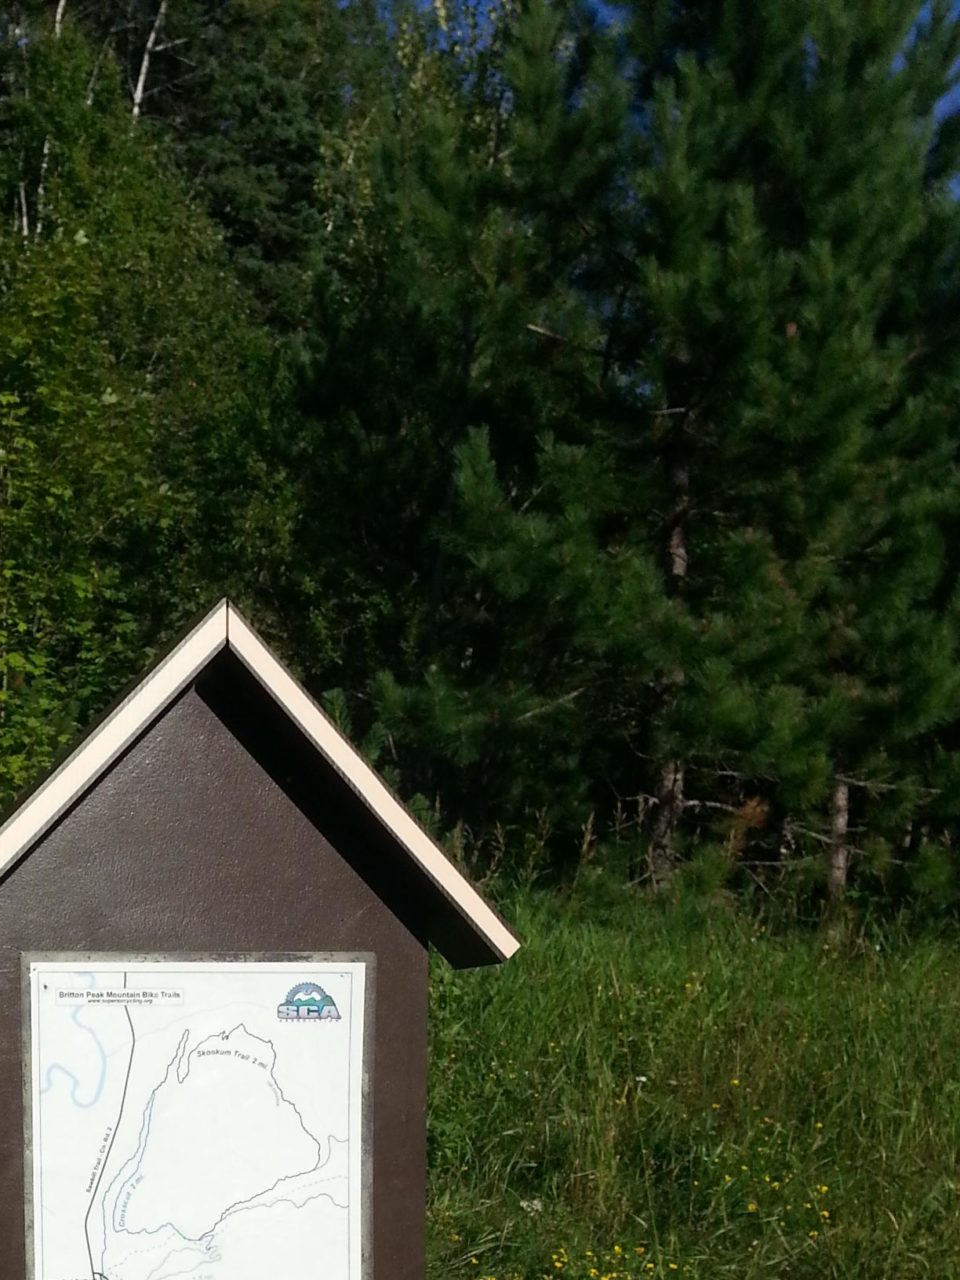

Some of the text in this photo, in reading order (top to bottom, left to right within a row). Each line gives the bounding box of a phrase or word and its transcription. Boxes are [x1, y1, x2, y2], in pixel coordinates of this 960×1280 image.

[58, 991, 85, 999] Britton
[86, 991, 104, 999] Peak
[106, 991, 141, 999] Mountain
[277, 1004, 342, 1020] SCA
[196, 1048, 232, 1058] Skookum
[233, 1050, 250, 1061] Trail
